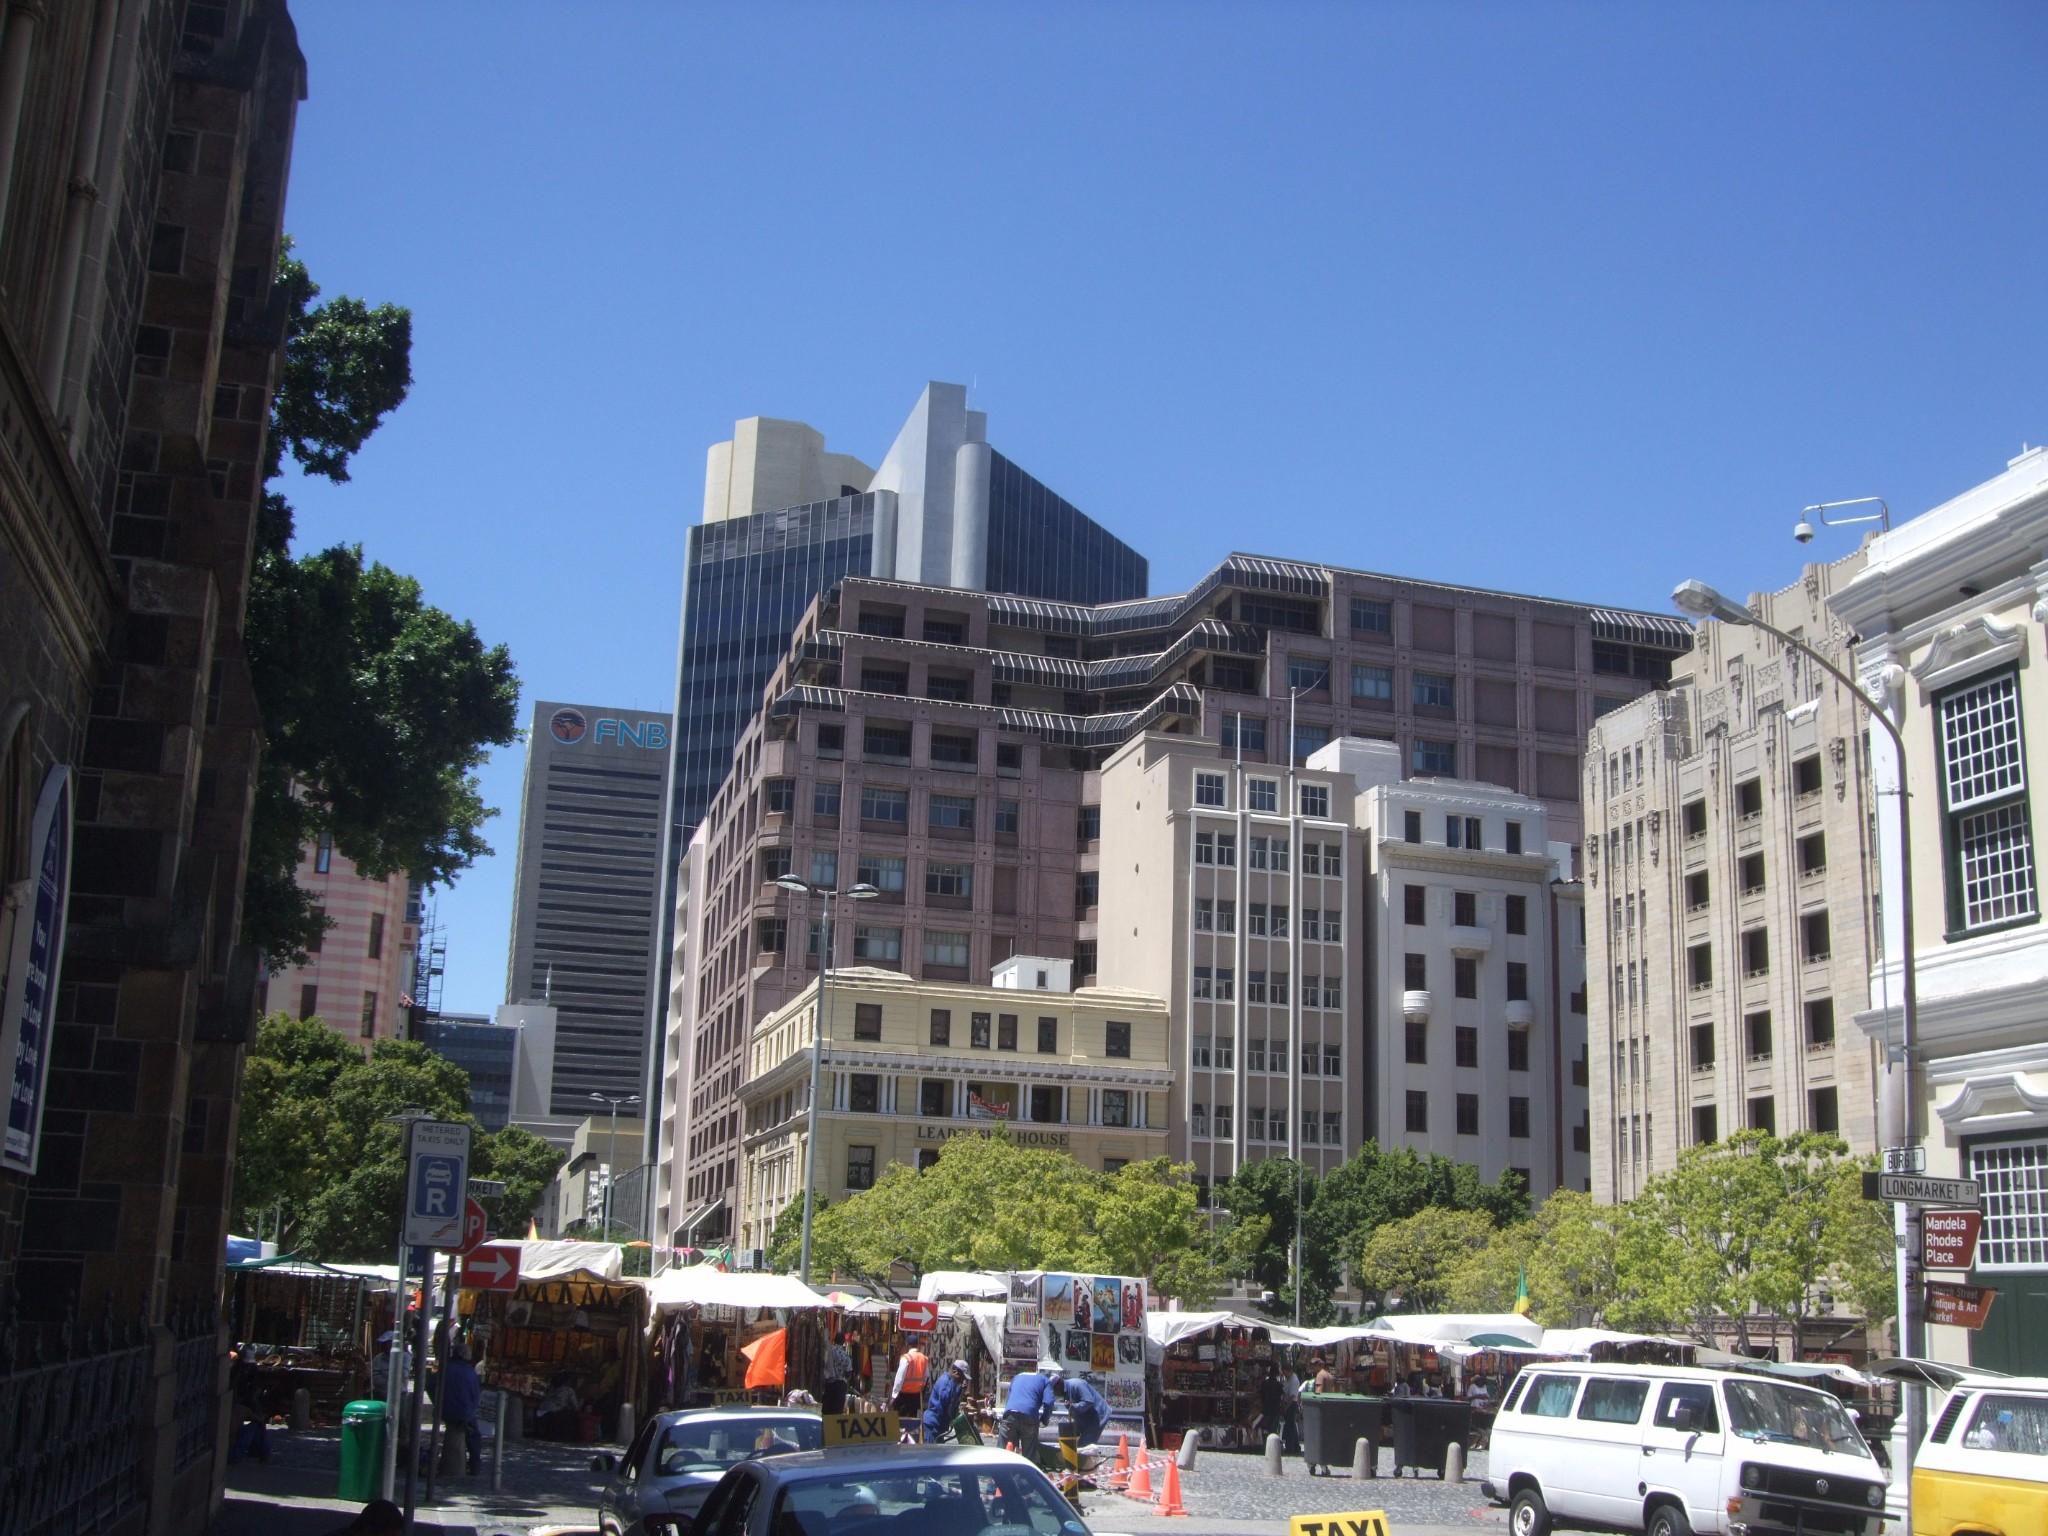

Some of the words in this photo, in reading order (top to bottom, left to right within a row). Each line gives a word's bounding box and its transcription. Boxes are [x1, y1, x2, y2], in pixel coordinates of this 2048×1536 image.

[594, 718, 668, 749] FNB
[36, 920, 47, 949] You
[29, 1000, 41, 1029] Love
[25, 1040, 37, 1068] Love
[21, 1080, 34, 1106] Love
[422, 1125, 461, 1135] METERED
[417, 1134, 441, 1144] TAXIS
[445, 1136, 466, 1146] ONLY
[1017, 1131, 1069, 1146] HOUSE
[1888, 1153, 1910, 1170] BURG
[1911, 1151, 1919, 1162] ST
[469, 1181, 493, 1194] RKET
[1886, 1179, 1960, 1200] LONGMARKET
[1965, 1185, 1974, 1196] ST
[426, 1188, 446, 1213] R
[1925, 1217, 1967, 1230] Mandela
[1926, 1234, 1963, 1247] Rhodes
[1926, 1249, 1954, 1263] Place
[1931, 1284, 1954, 1297] Church
[1956, 1287, 1978, 1300] Street
[1931, 1297, 1956, 1312] Antique
[1958, 1299, 1964, 1311] &
[1966, 1302, 1978, 1313] Art
[1929, 1310, 1953, 1322] Market
[717, 1391, 749, 1403] TAXI
[837, 1417, 887, 1439] TAXI
